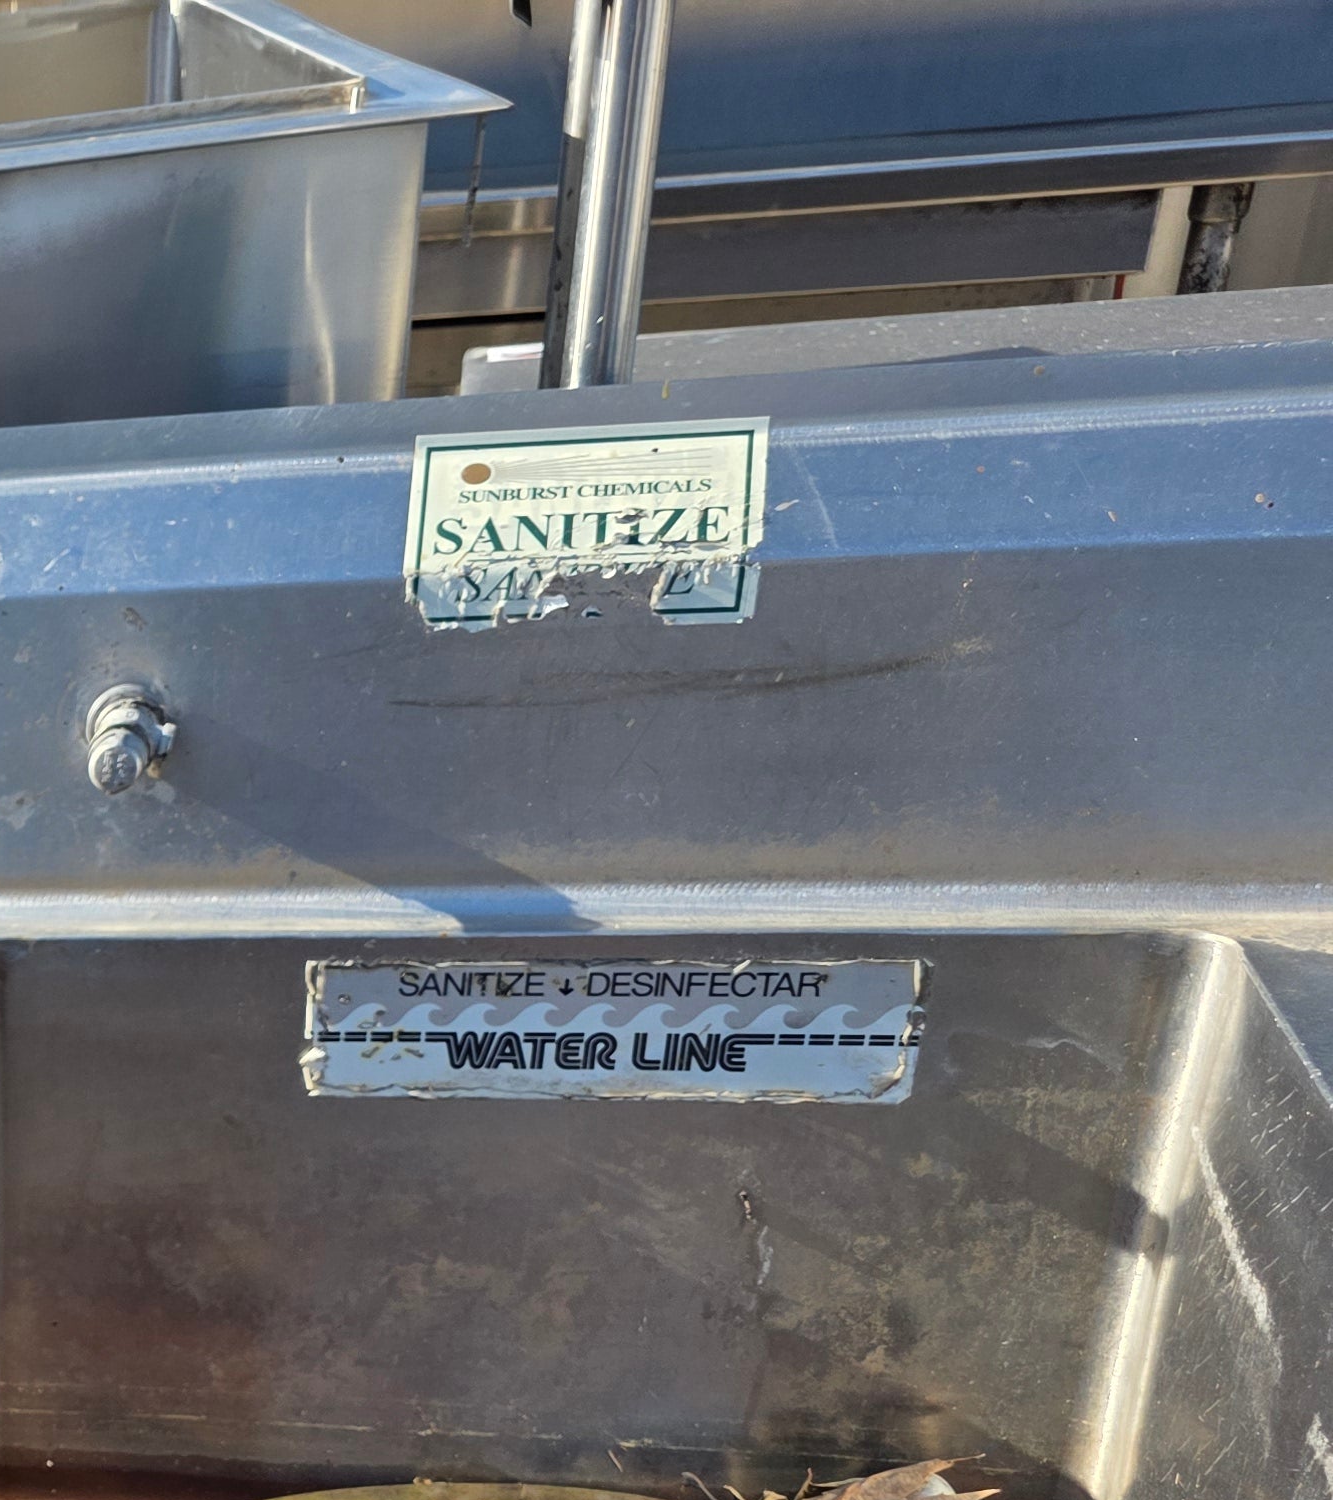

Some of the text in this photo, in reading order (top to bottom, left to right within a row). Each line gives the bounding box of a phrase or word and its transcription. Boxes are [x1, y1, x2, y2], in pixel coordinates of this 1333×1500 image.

[459, 478, 713, 504] SUNBURST CHEMICALS
[432, 505, 730, 556] SANITIZE
[398, 971, 823, 998] SANITIZE DESINFECTAR
[445, 1030, 747, 1073] WATER LINE
